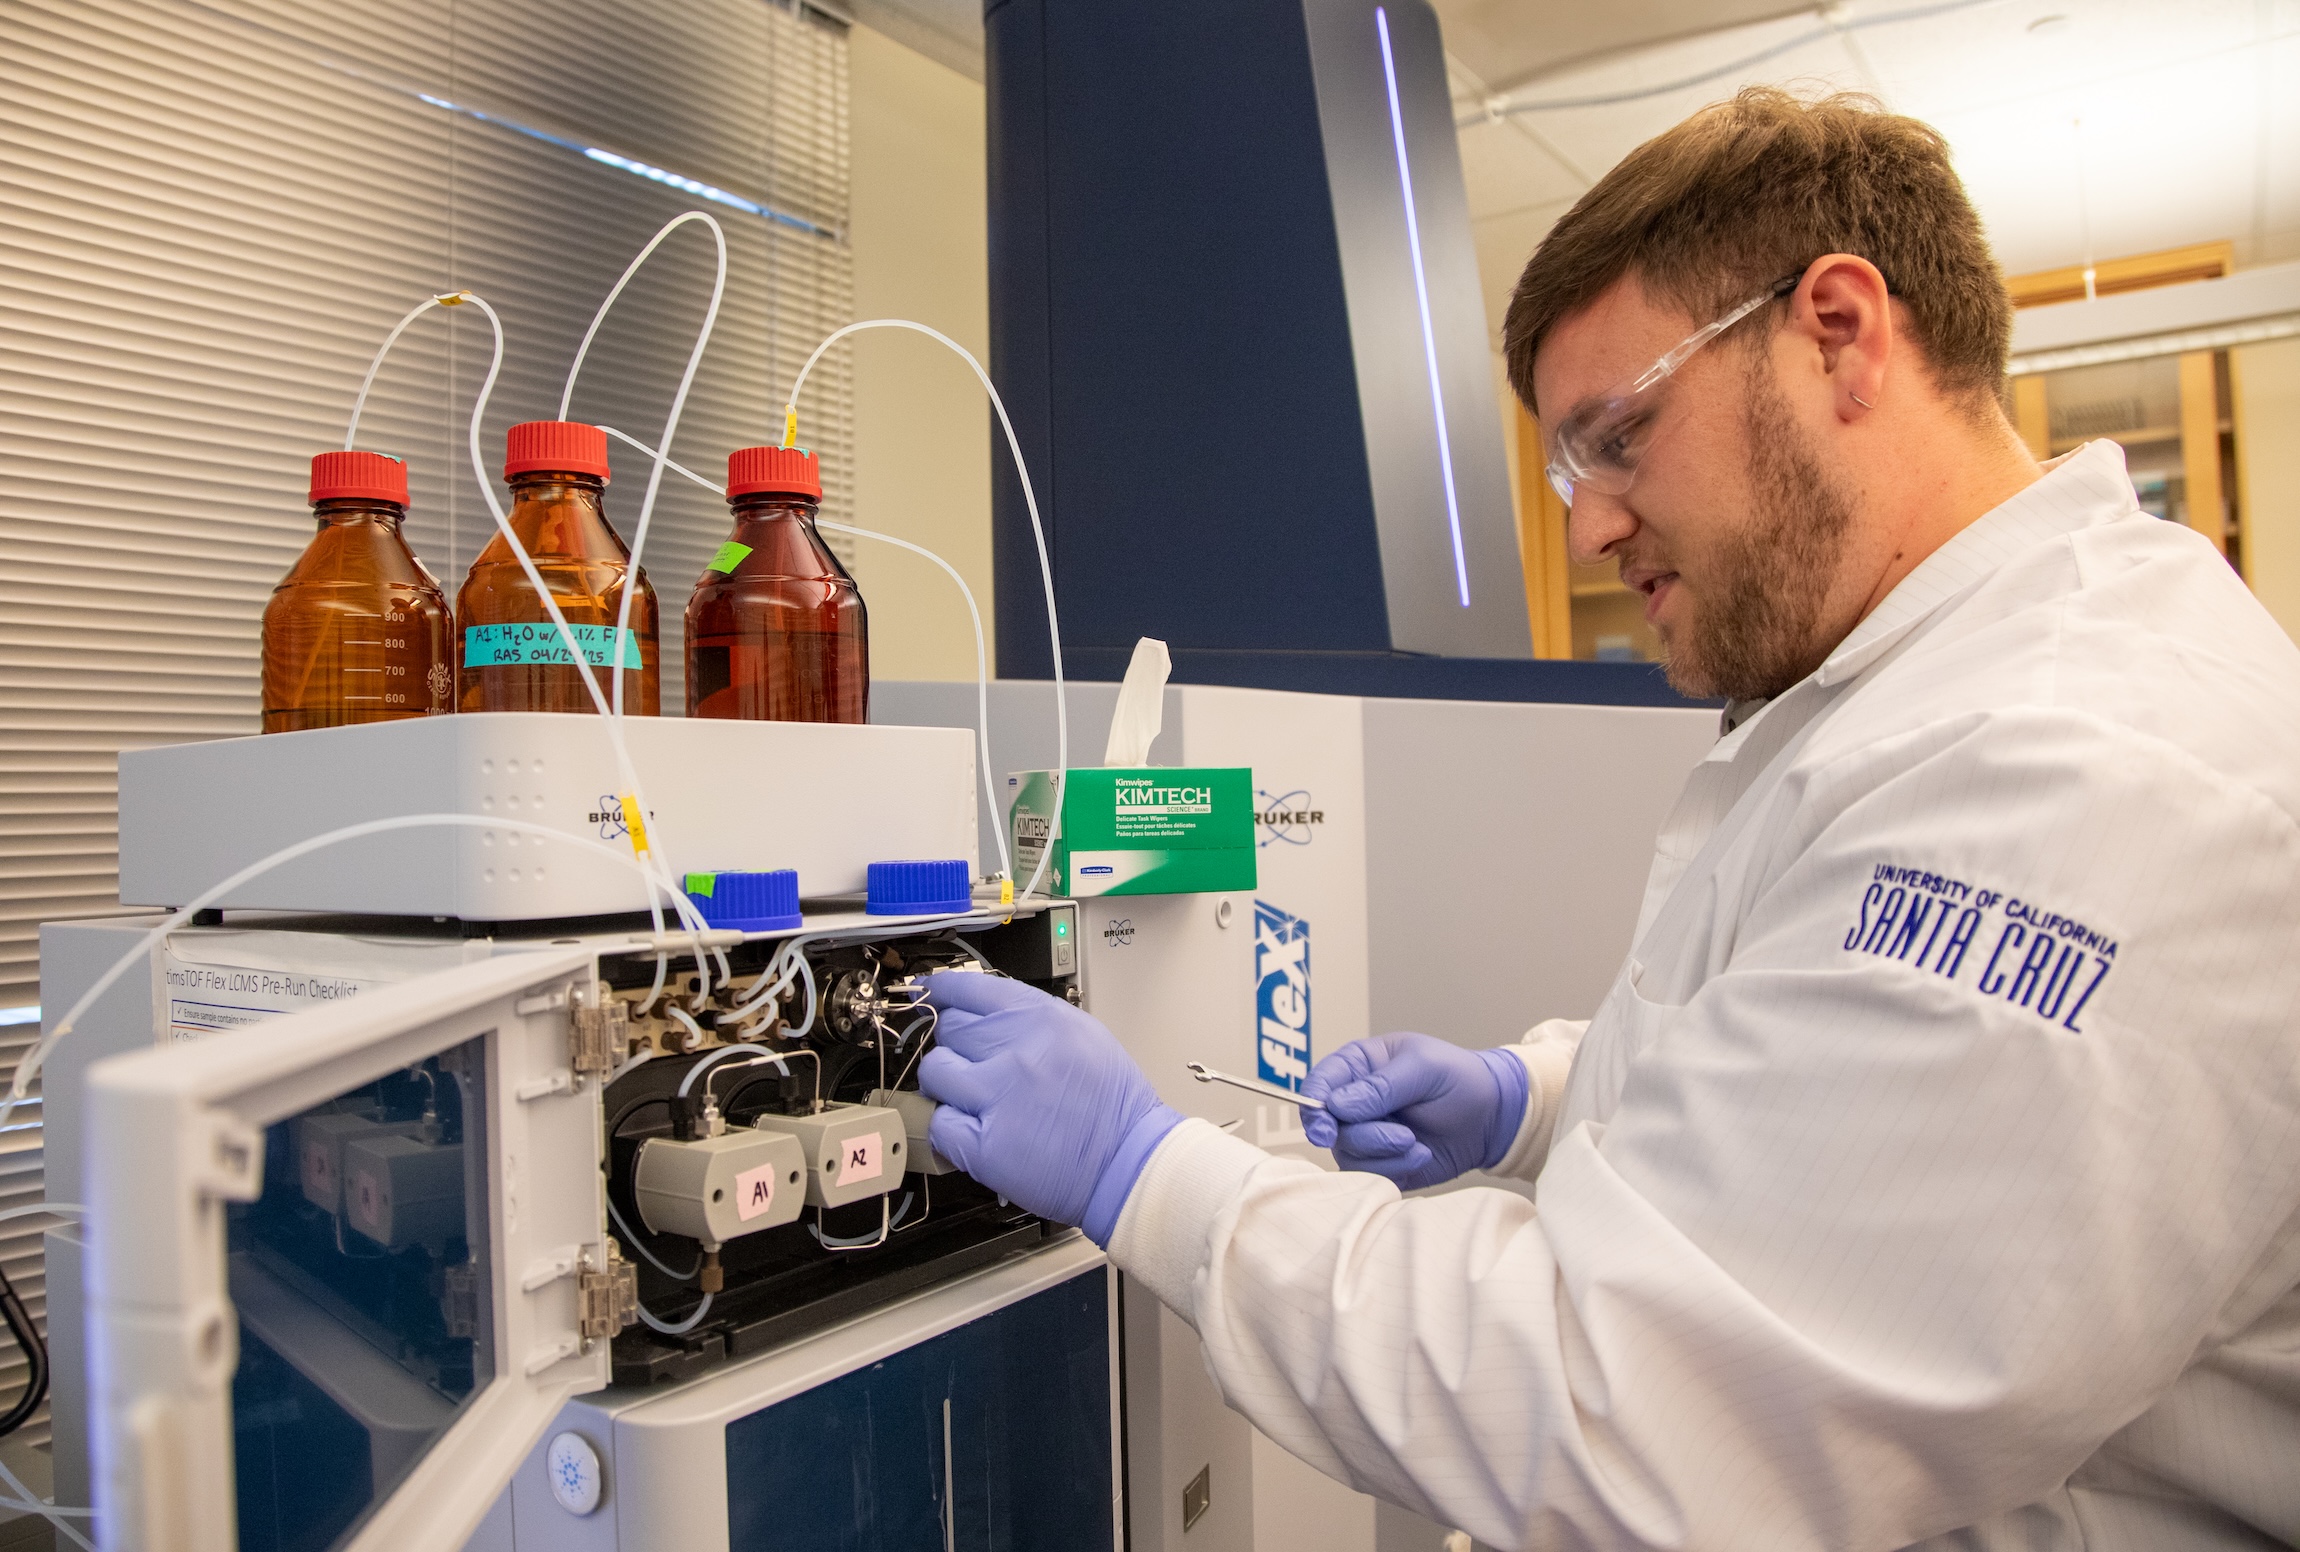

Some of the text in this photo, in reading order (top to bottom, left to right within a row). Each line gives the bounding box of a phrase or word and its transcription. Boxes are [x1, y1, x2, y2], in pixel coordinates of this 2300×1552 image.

[385, 612, 405, 622] 900
[603, 628, 618, 643] F
[385, 639, 406, 649] 800
[493, 649, 521, 662] RAS
[385, 666, 406, 676] 700
[385, 693, 406, 704] 600
[1115, 778, 1153, 788] Kimwipes
[1115, 787, 1211, 805] KIMTECH
[1116, 815, 1137, 823] Delicate
[1150, 815, 1169, 823] Wipers
[1253, 810, 1325, 826] RUKER
[1016, 817, 1050, 837] KIMTECH
[1873, 863, 2119, 960] UNIVERSITY OF CALIFORNIA
[1103, 928, 1136, 938] BRUKER
[1843, 883, 2112, 1034] SANTA CRUZ
[166, 968, 358, 1001] timsTOF Flex LCMS Pre-Run Checklist
[1259, 918, 1308, 1080] flex
[184, 1007, 200, 1019] Ensure
[200, 1012, 217, 1022] sample
[217, 1014, 239, 1025] contains
[850, 1148, 867, 1169] A2
[752, 1180, 769, 1207] A1
